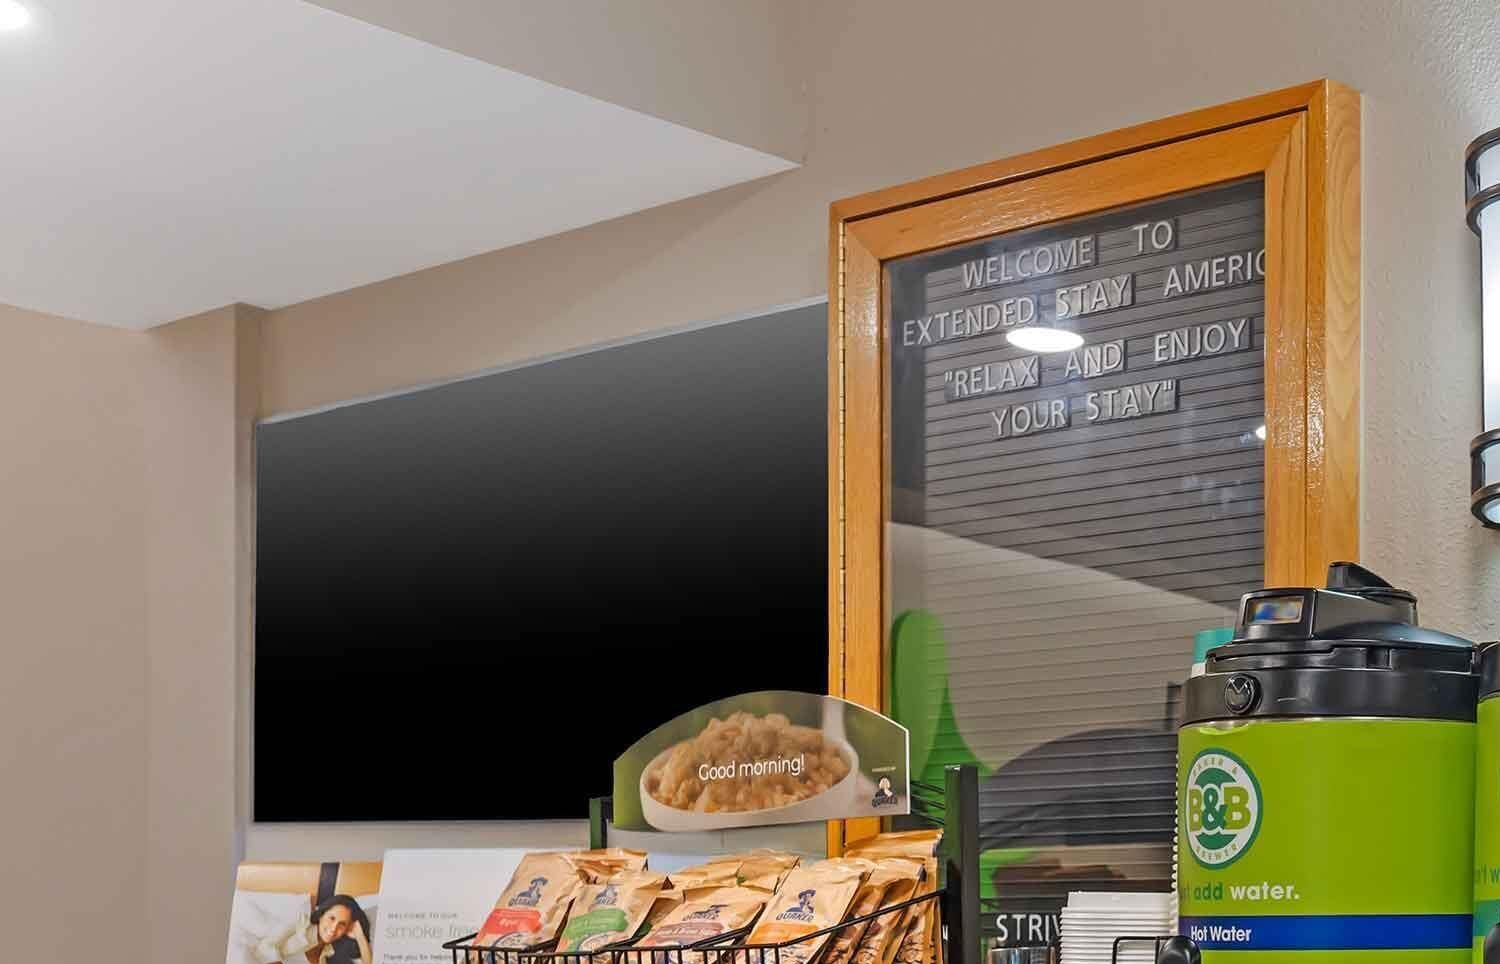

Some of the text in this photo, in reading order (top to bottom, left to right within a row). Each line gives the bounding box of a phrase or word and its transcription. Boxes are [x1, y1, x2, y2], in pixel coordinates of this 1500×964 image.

[962, 221, 1173, 290] WELCOME TO
[903, 296, 1035, 347] EXTENDED
[1056, 275, 1131, 317] STAY
[944, 318, 1249, 398] "RELAX AND ENJOY
[991, 380, 1174, 438] YOUR STAY"
[698, 753, 806, 781] Good morning!
[1188, 786, 1252, 832] B&B
[1193, 882, 1223, 901] add
[1229, 881, 1301, 901] water.
[1190, 925, 1252, 942] Hot Water
